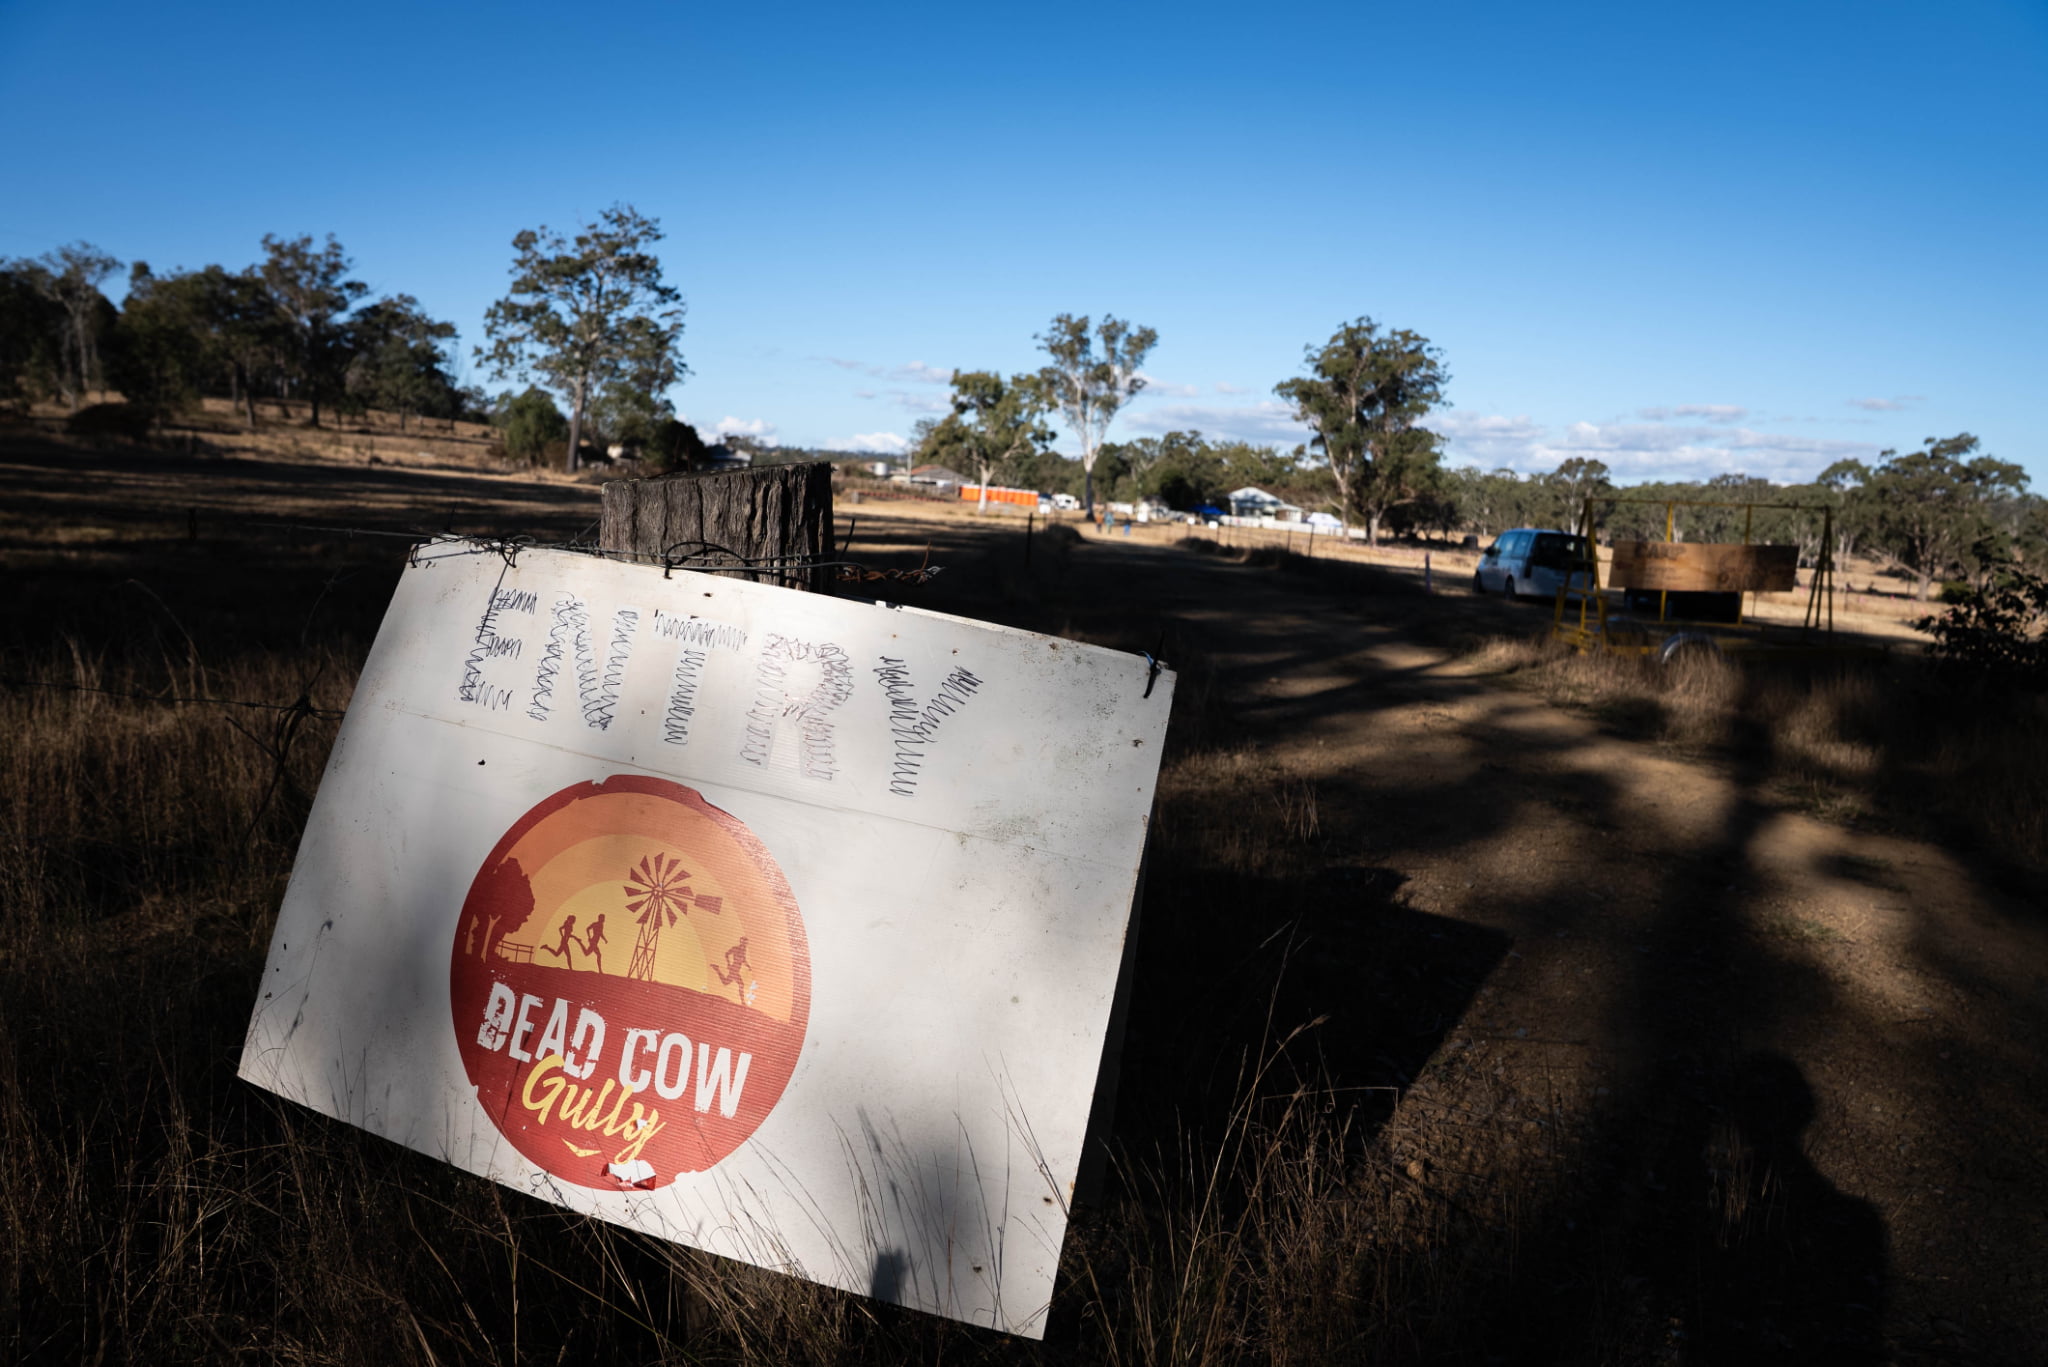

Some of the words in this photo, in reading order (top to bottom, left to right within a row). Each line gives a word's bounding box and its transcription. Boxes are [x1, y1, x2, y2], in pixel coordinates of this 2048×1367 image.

[461, 587, 983, 796] ENTRY
[477, 981, 607, 1080] DEAD
[618, 1027, 752, 1119] COW
[522, 1054, 667, 1165] Gully
